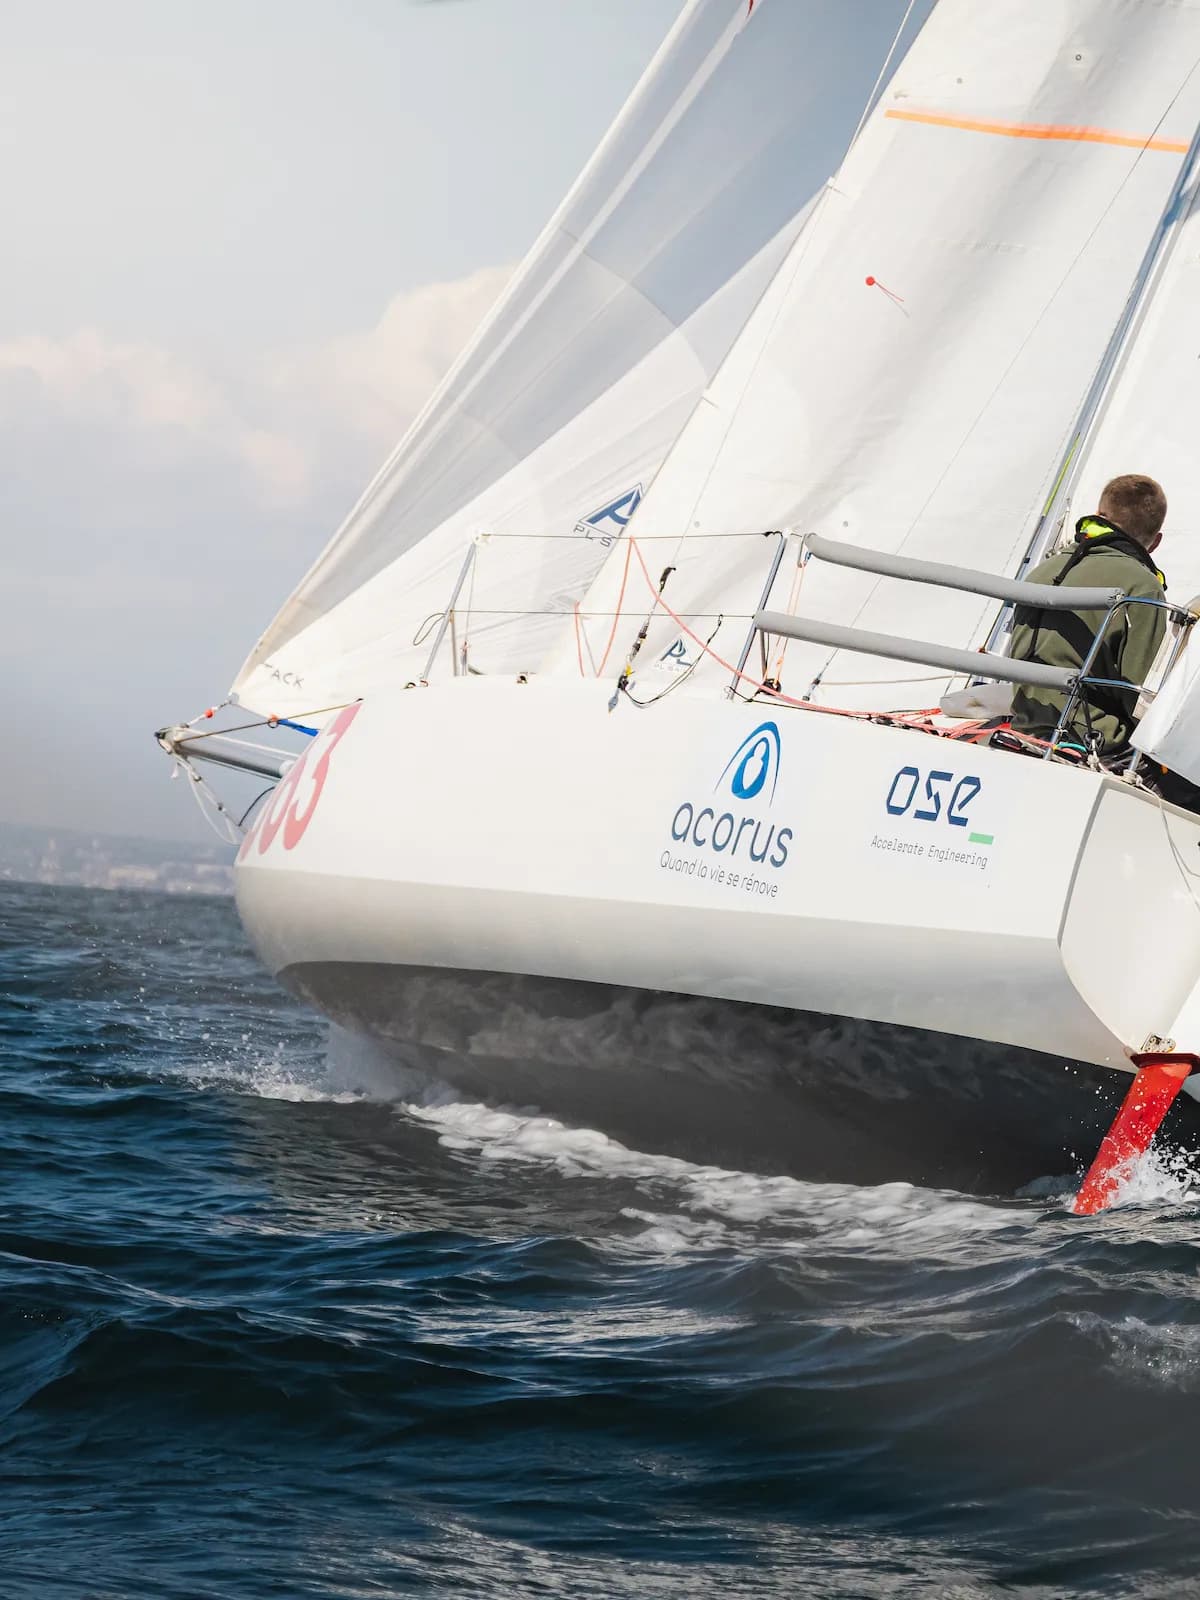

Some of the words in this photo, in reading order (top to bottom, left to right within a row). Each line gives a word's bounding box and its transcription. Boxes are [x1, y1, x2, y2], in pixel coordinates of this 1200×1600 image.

[264, 663, 304, 689] TACK
[671, 802, 793, 868] acorus
[871, 834, 924, 856] Accelerate
[928, 844, 988, 870] Engineering
[660, 850, 698, 876] Quand
[699, 859, 708, 877] la
[710, 864, 725, 883] vie
[727, 872, 740, 887] se
[740, 871, 778, 898] rénove
